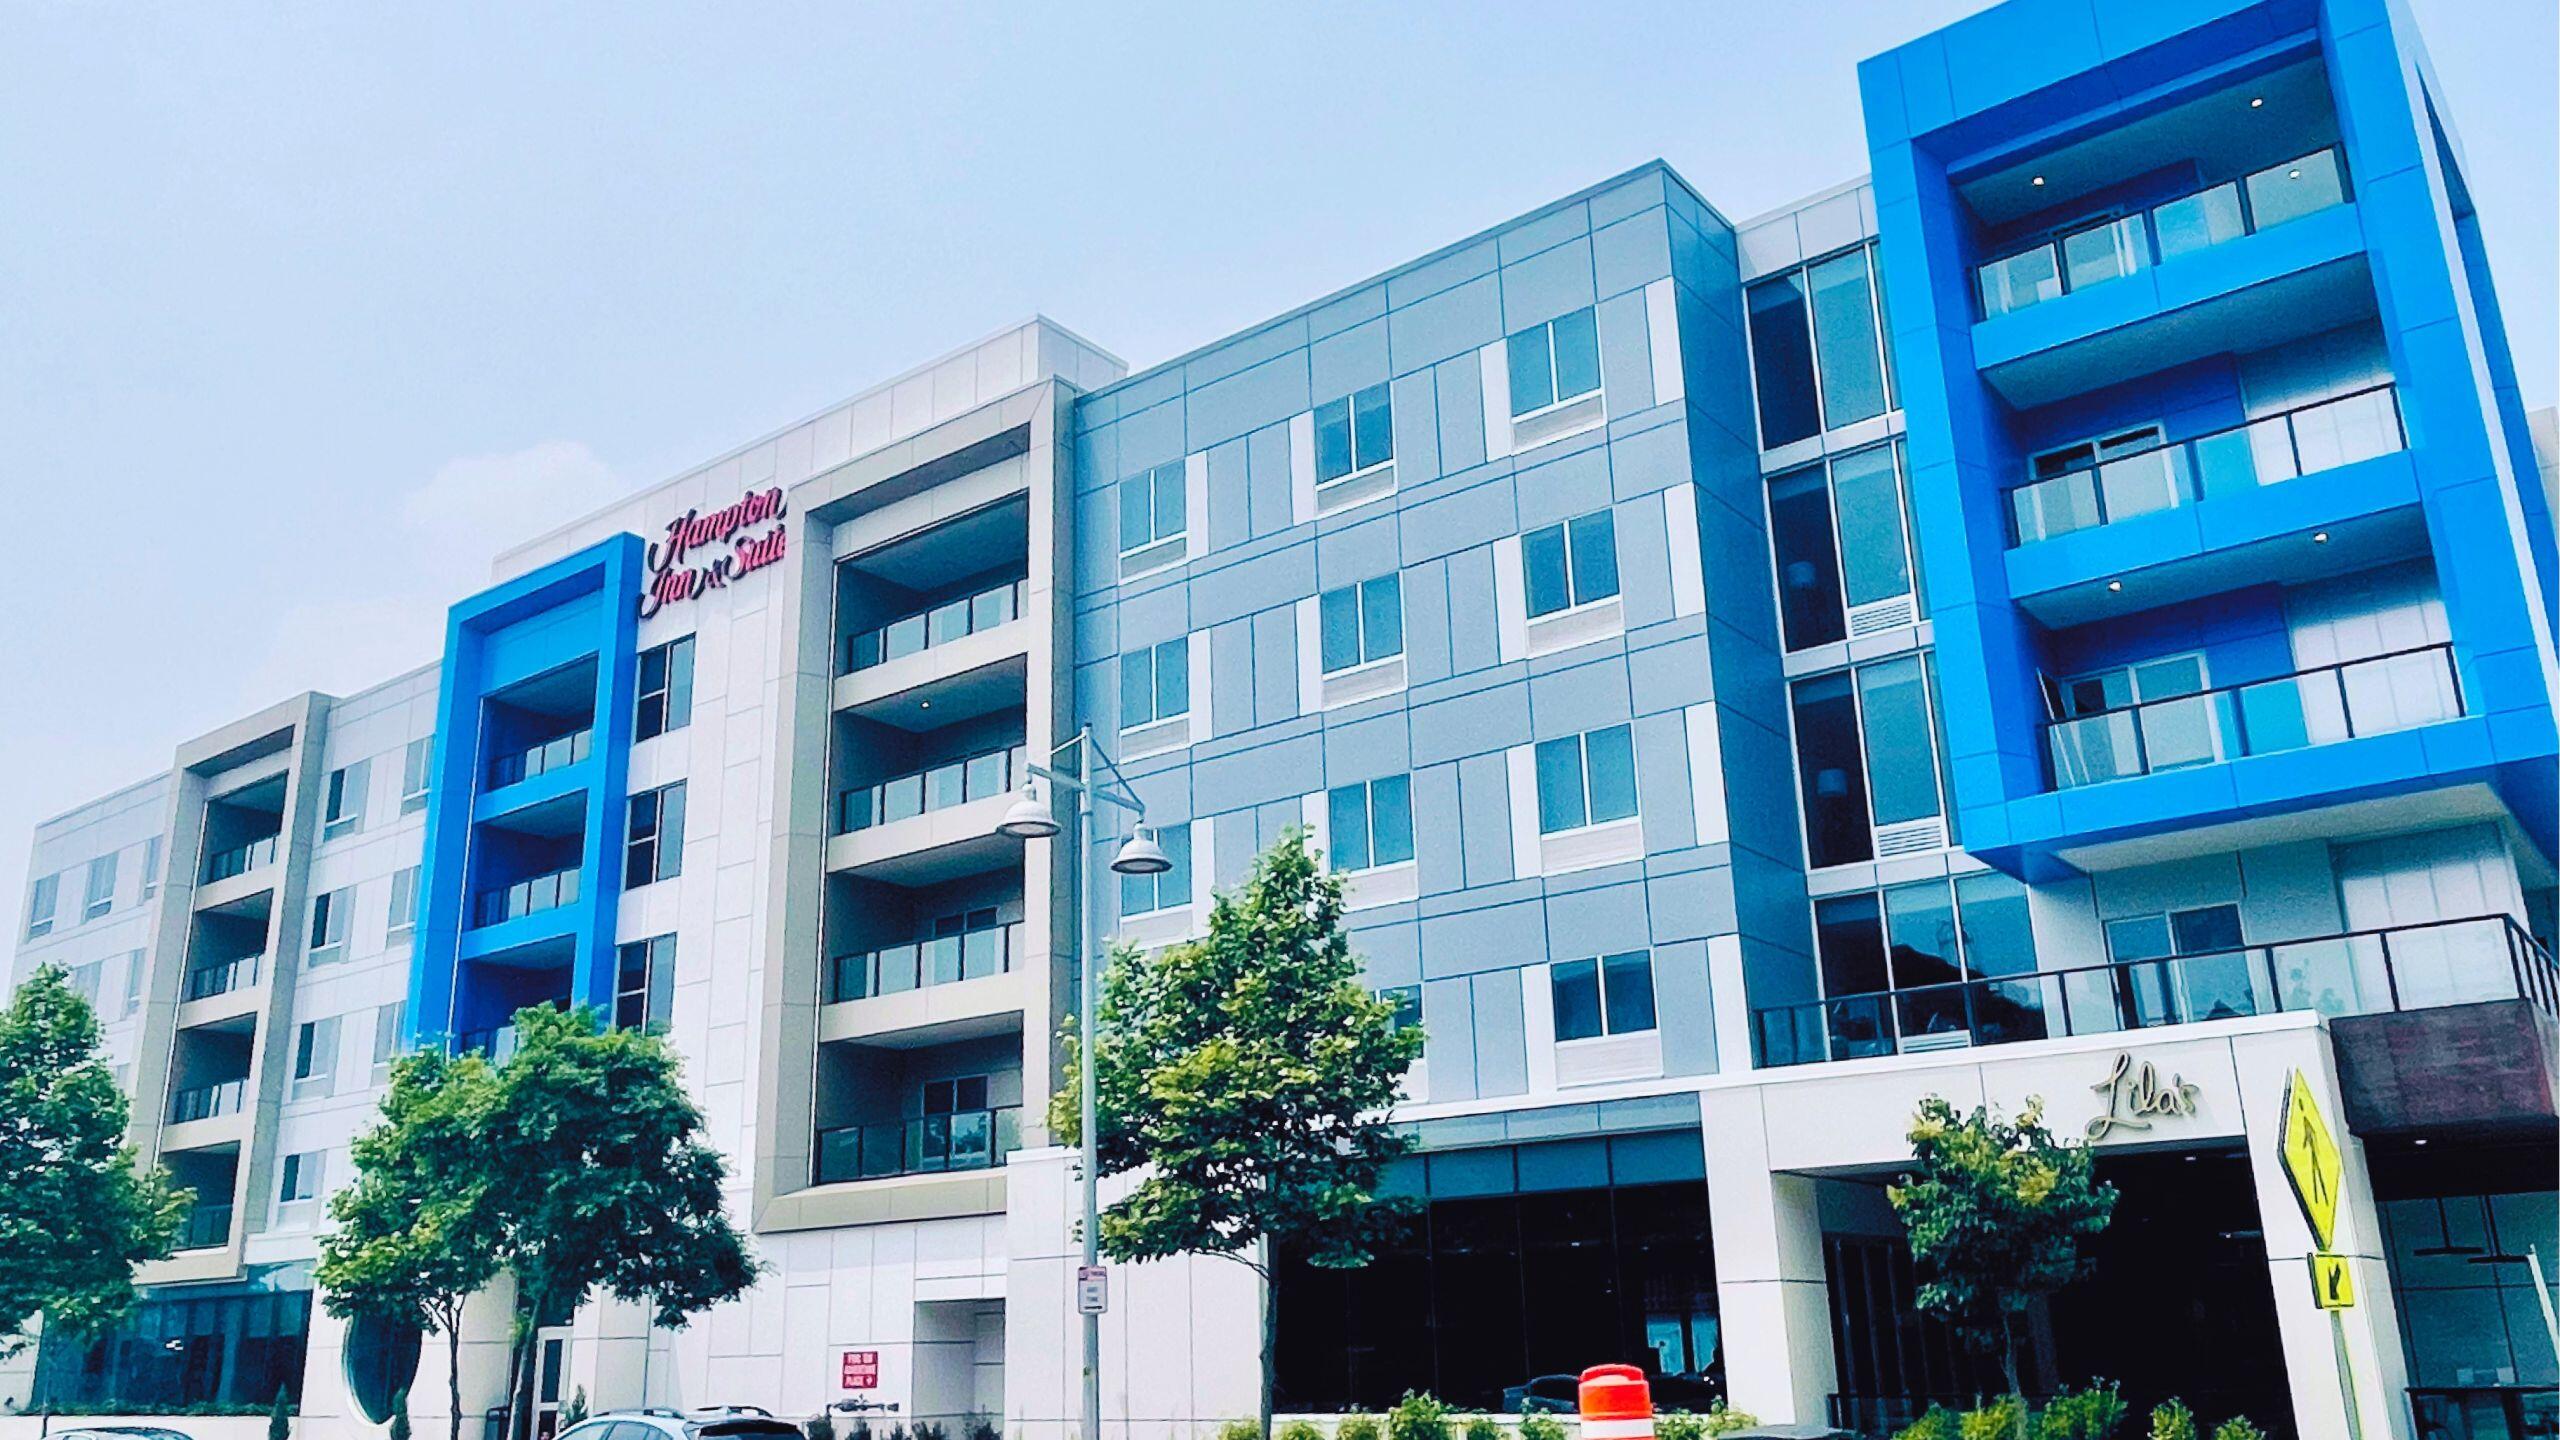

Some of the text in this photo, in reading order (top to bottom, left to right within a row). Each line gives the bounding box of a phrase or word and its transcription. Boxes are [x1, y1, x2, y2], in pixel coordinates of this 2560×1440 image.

[638, 522, 786, 620] Inn & Suite
[648, 486, 788, 574] Hampton
